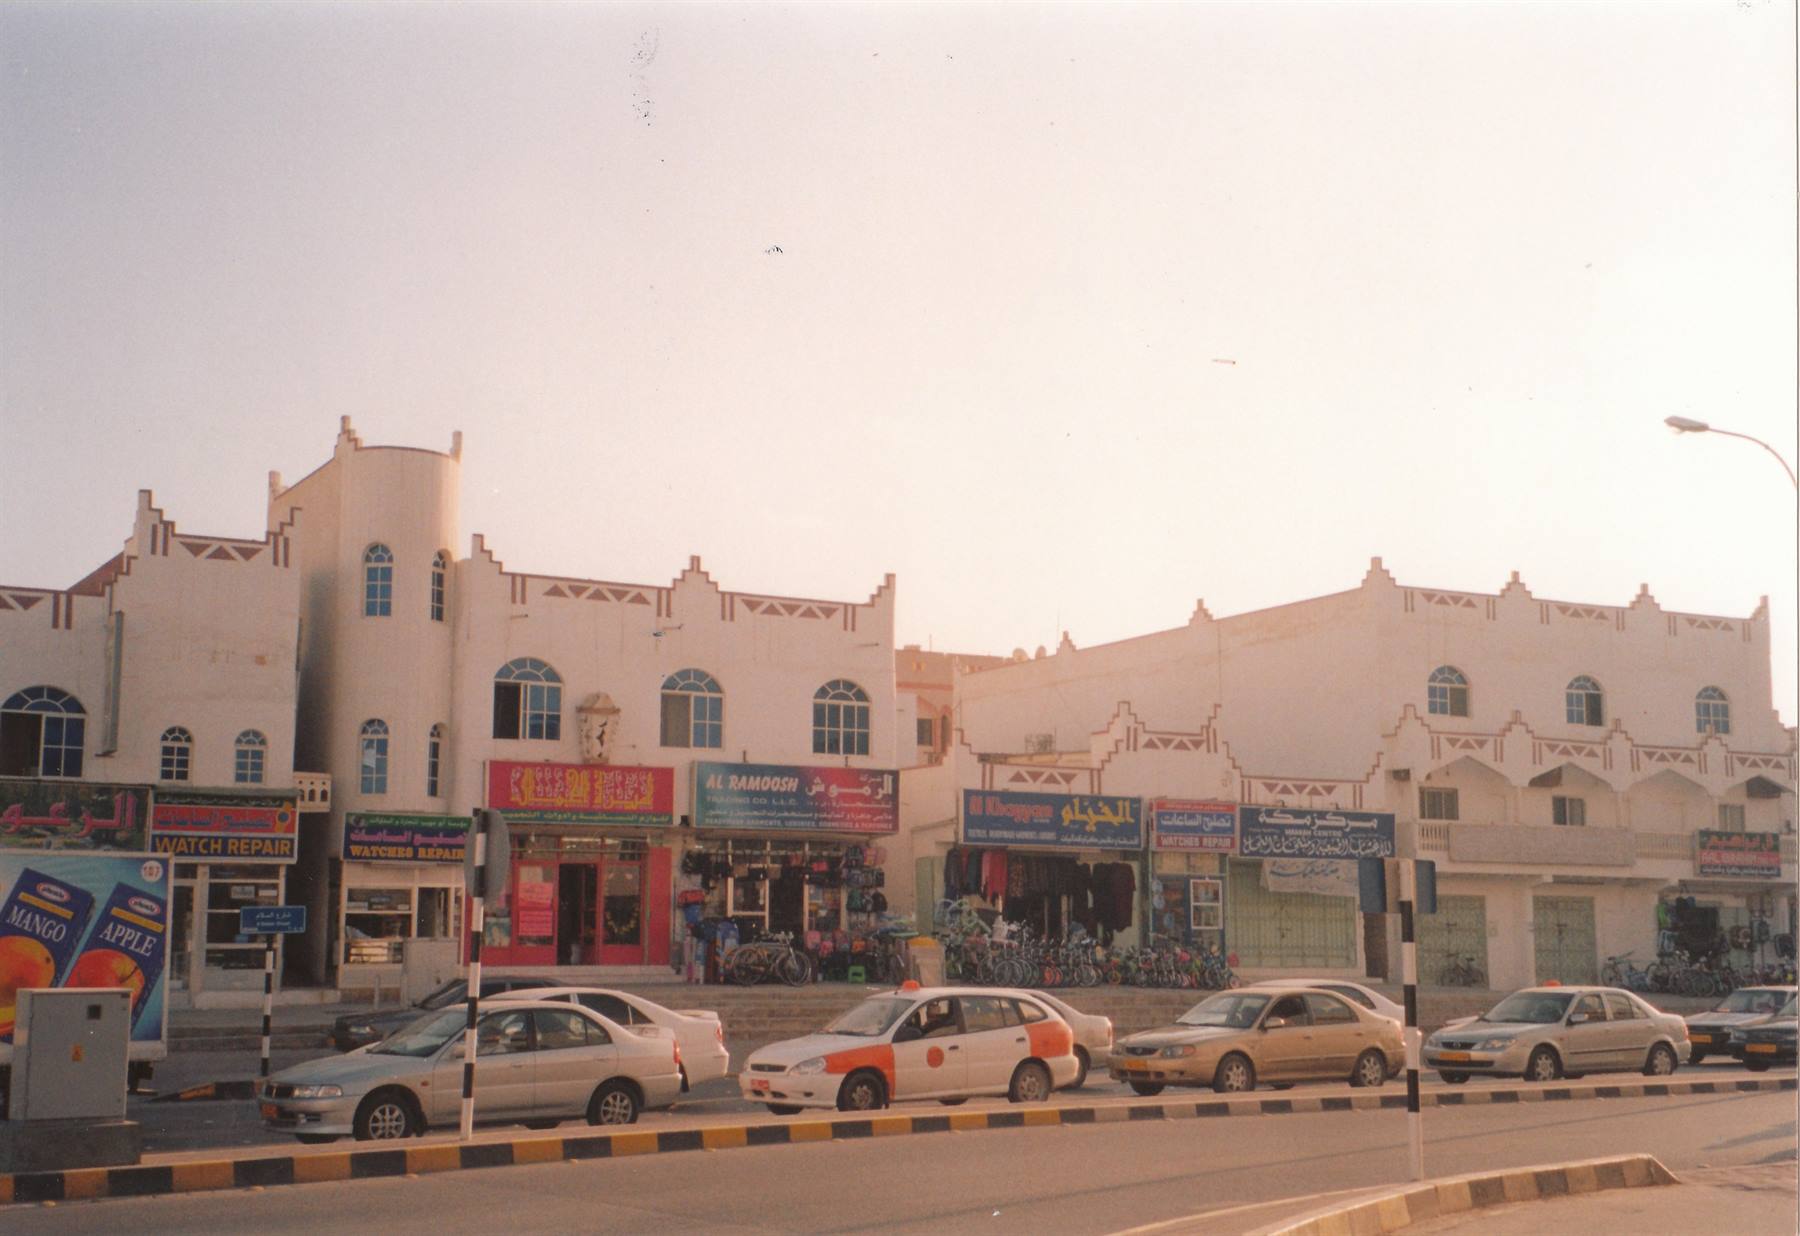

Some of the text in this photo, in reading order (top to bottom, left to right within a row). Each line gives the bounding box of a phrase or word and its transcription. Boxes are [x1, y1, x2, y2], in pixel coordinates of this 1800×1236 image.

[706, 774, 799, 792] AL RAMOOSH
[805, 774, 893, 800] الرموش
[1258, 808, 1378, 832] مركز مكة
[156, 837, 291, 855] WATCH REPAIR
[1161, 836, 1231, 848] WATCHES REPAIR
[5, 905, 67, 942] MANGO
[99, 921, 157, 957] APPLE
